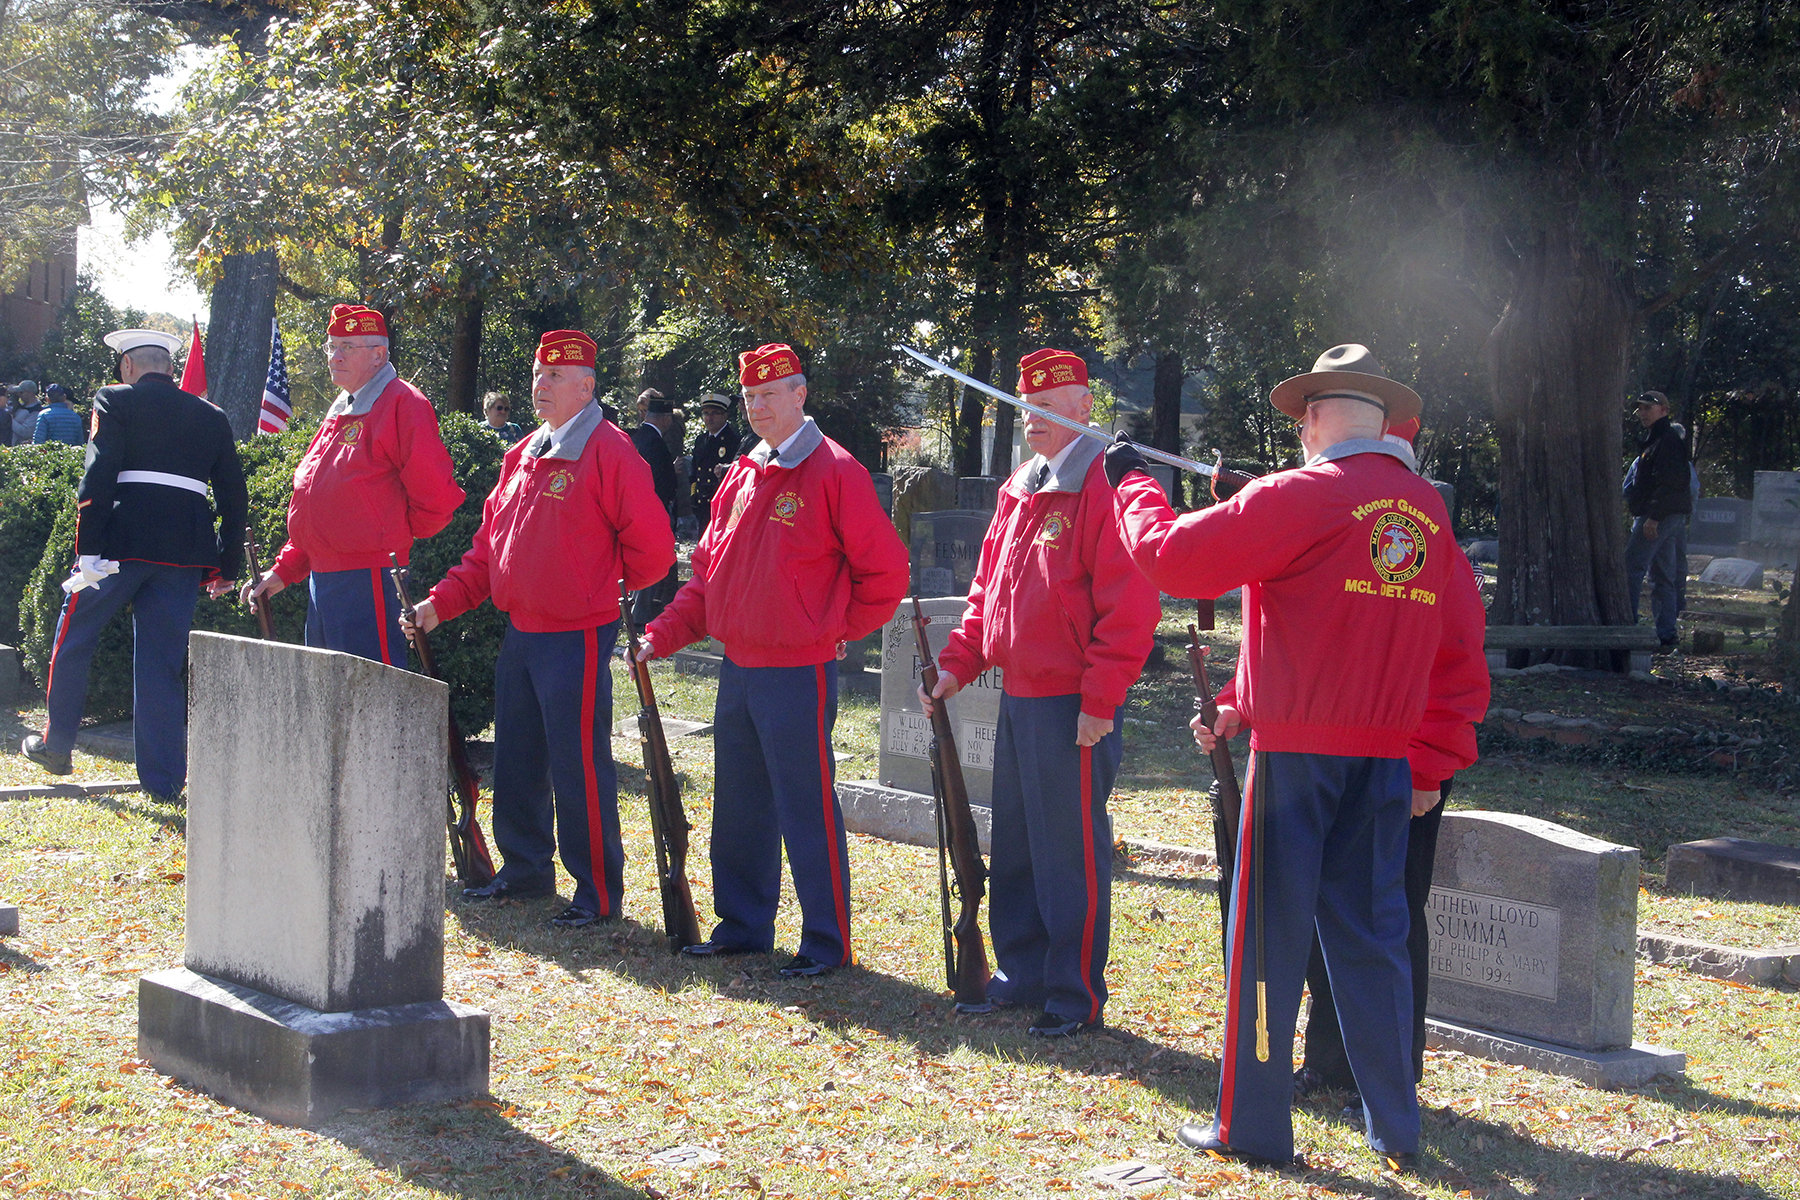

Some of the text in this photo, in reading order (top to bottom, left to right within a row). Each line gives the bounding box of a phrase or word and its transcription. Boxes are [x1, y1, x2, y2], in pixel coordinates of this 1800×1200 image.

[1049, 364, 1073, 373] MARINE
[1053, 370, 1074, 378] CORPS
[1052, 376, 1077, 384] LEAGUE
[781, 519, 795, 527] Guard
[1351, 498, 1440, 535] Honor Guard
[1372, 514, 1424, 552] MARINE CORPS LEAGUE
[936, 542, 980, 560] FESMIR
[1373, 557, 1419, 581] SEMPER FIDELIS
[1345, 579, 1436, 605] MCL. DET. #750
[893, 728, 910, 740] SEPT.
[975, 727, 996, 741] HELE
[891, 740, 909, 752] JULY
[967, 753, 982, 764] FEB.
[1426, 893, 1539, 928] TTHEW LLOYD
[1435, 914, 1508, 948] SUMMA
[1429, 938, 1548, 974] OF PHILIP & MARY
[1431, 956, 1455, 974] FEB.
[1481, 966, 1512, 985] 1994
